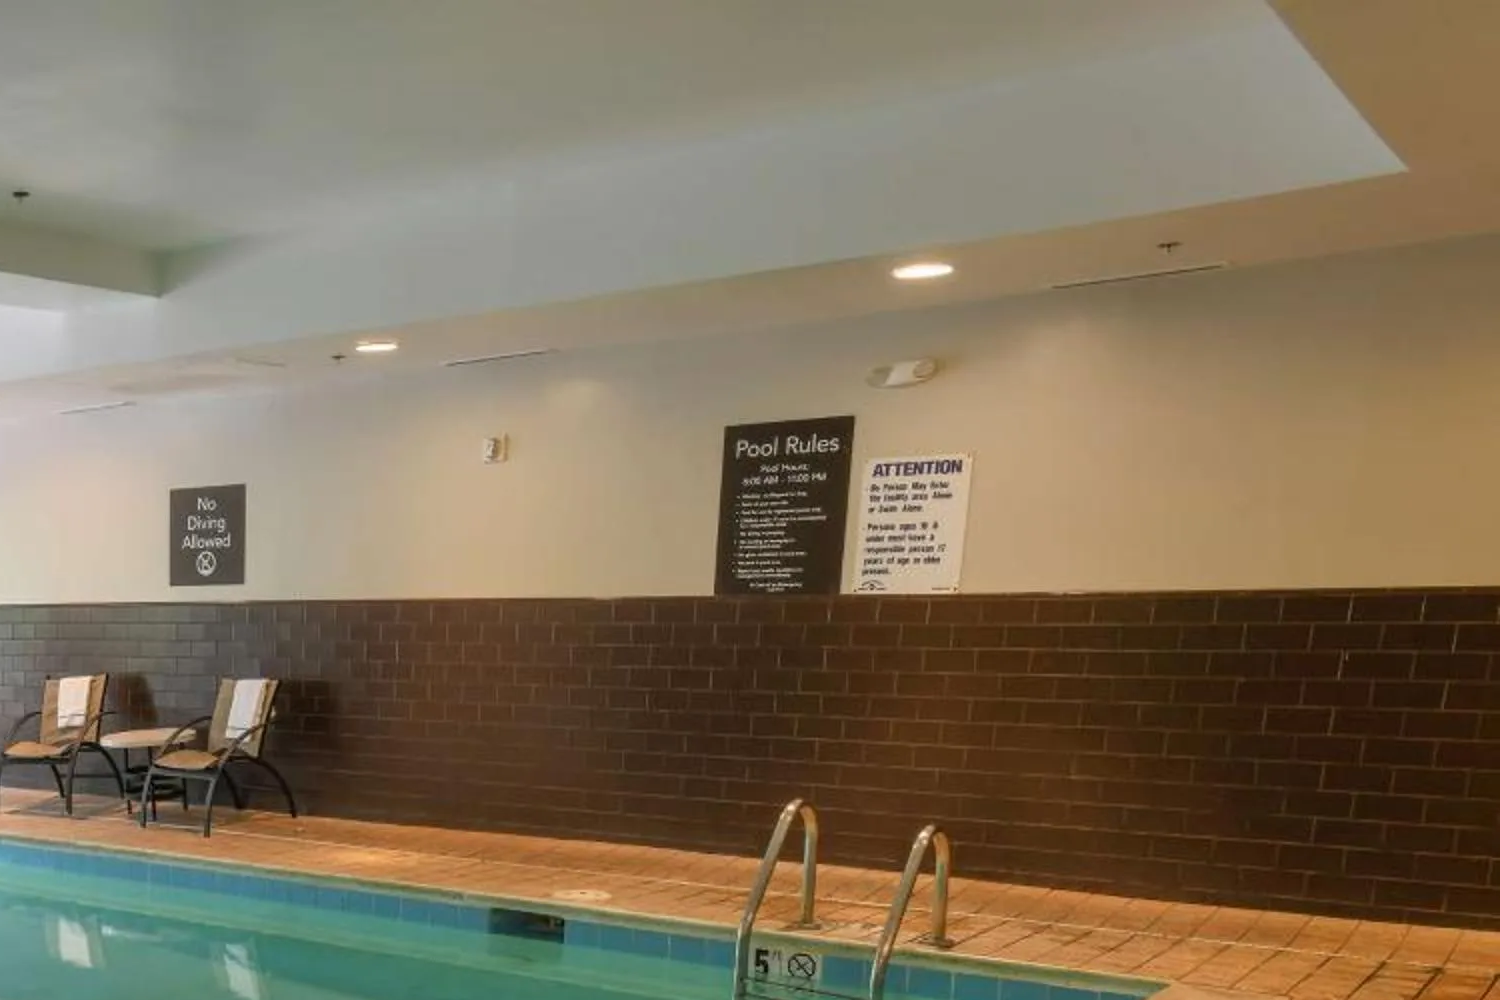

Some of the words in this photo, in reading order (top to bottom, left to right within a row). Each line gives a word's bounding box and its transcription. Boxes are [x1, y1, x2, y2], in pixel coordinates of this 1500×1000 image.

[734, 435, 780, 460] Pool
[785, 432, 841, 456] Rules
[811, 472, 827, 481] PM
[871, 459, 964, 478] ATTENTION
[911, 481, 927, 491] May
[197, 496, 218, 511] No
[187, 515, 227, 533] Diving
[182, 532, 232, 549] Allowed
[754, 948, 769, 975] 5
